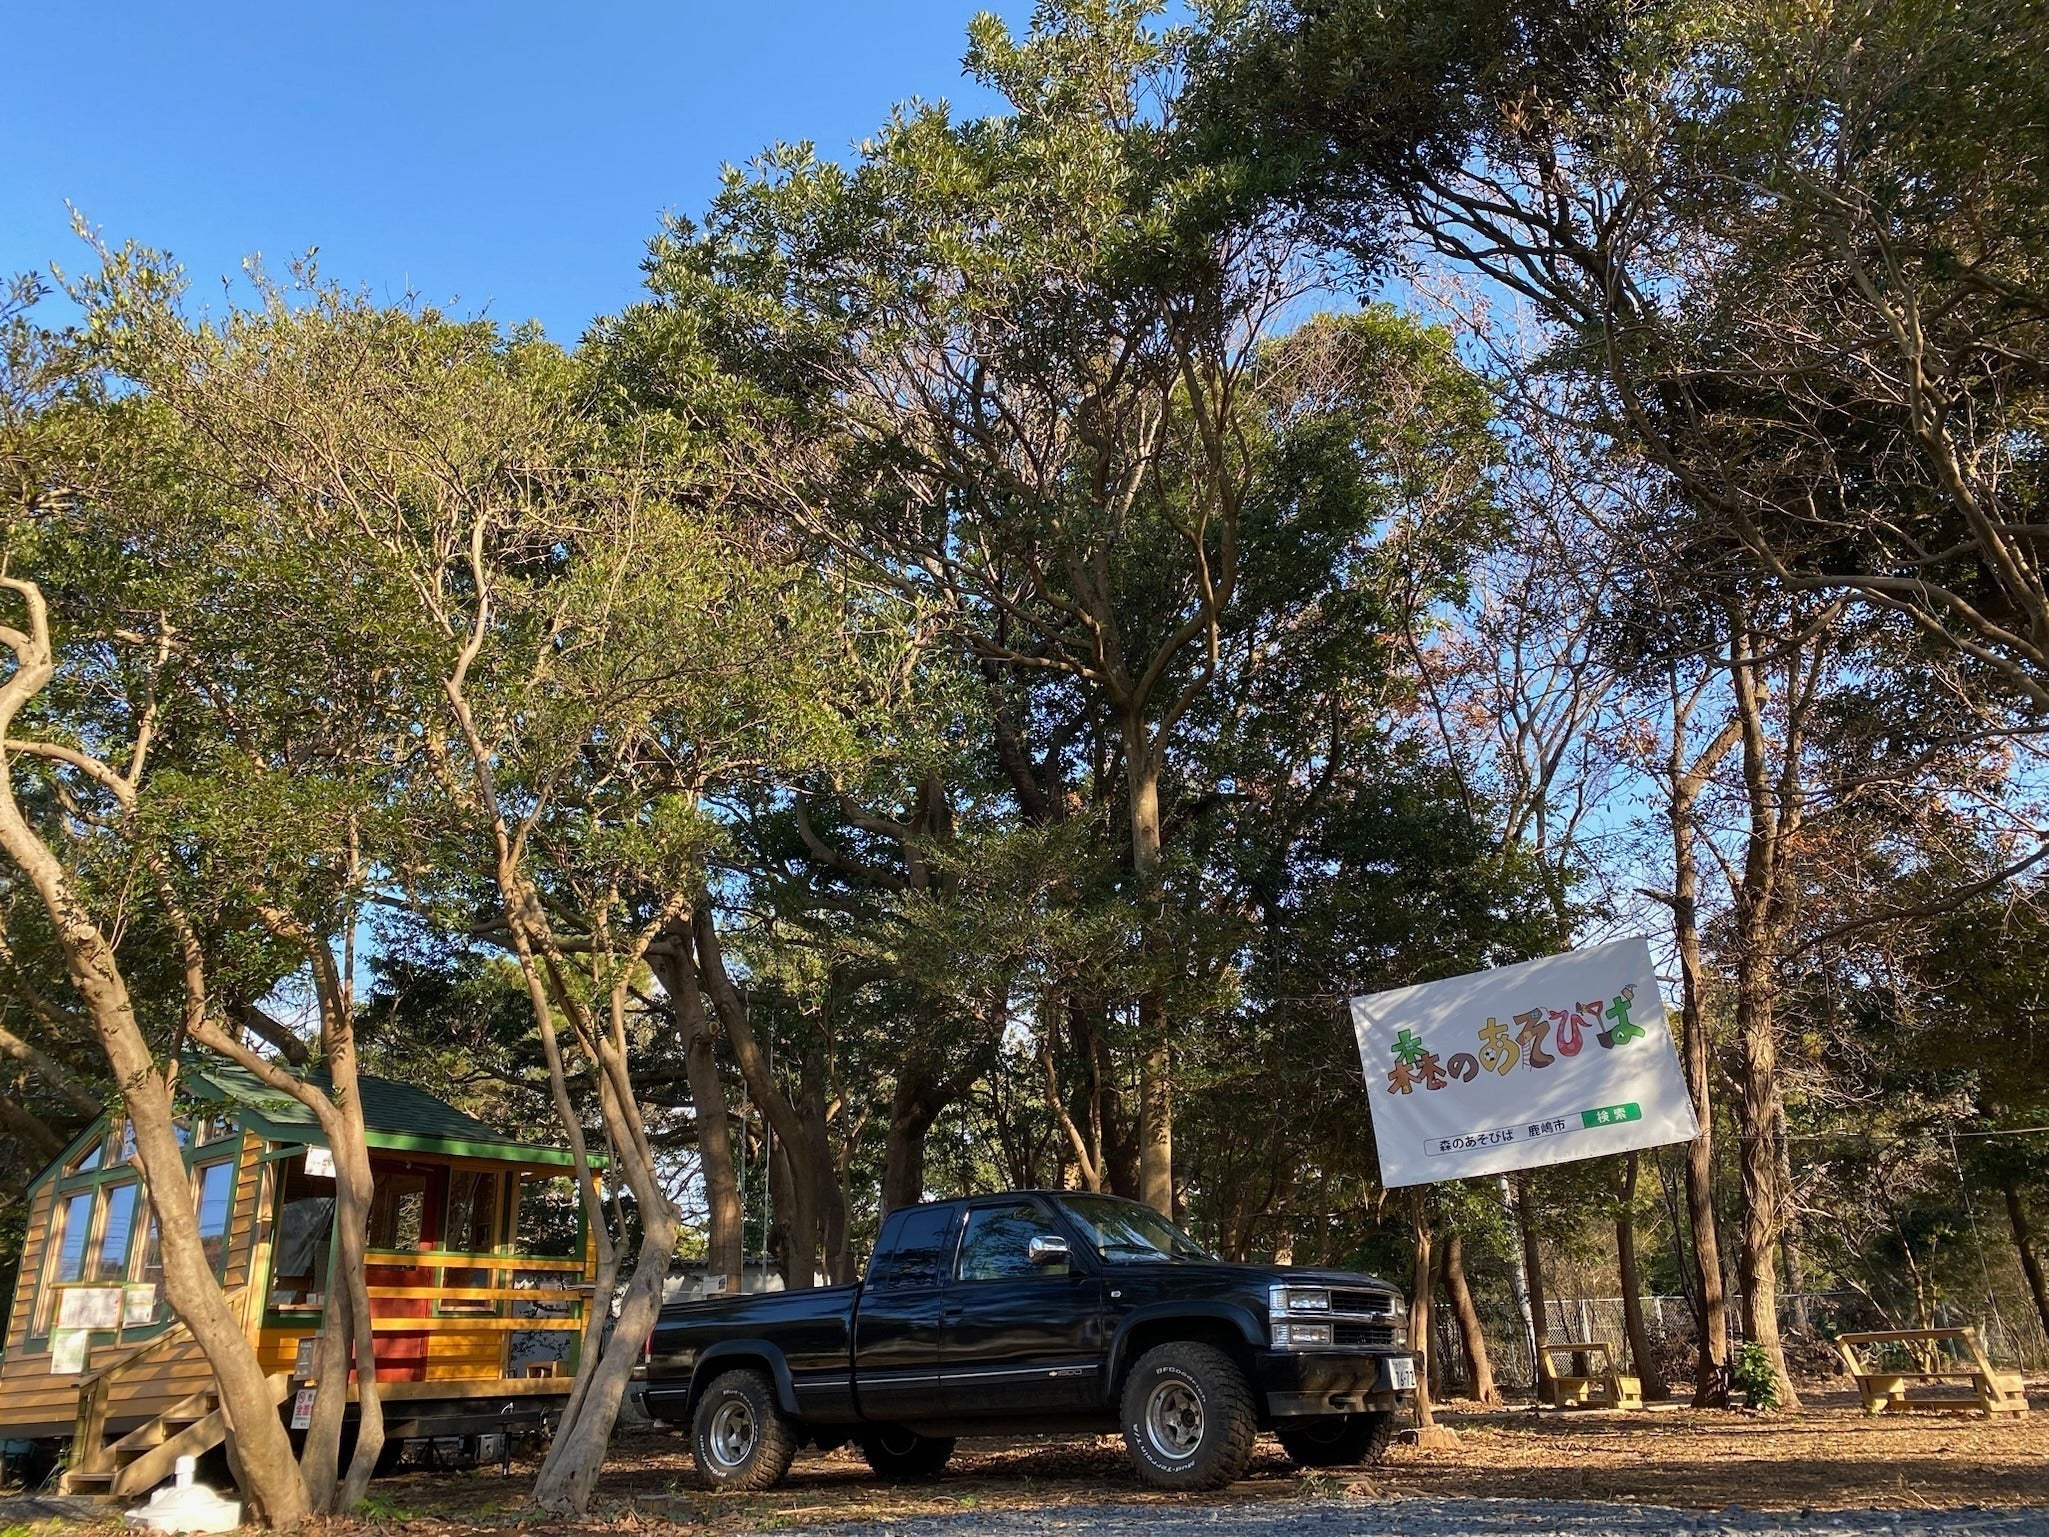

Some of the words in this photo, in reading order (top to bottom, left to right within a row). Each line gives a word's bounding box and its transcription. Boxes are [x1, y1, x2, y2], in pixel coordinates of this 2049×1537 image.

[1387, 984, 1646, 1095] 森のあそびば
[1596, 1106, 1628, 1124] 検索
[1439, 1128, 1514, 1152] 森のあそびば
[1527, 1118, 1566, 1138] 鹿嶋市
[1156, 1366, 1206, 1402] BFGoodrich
